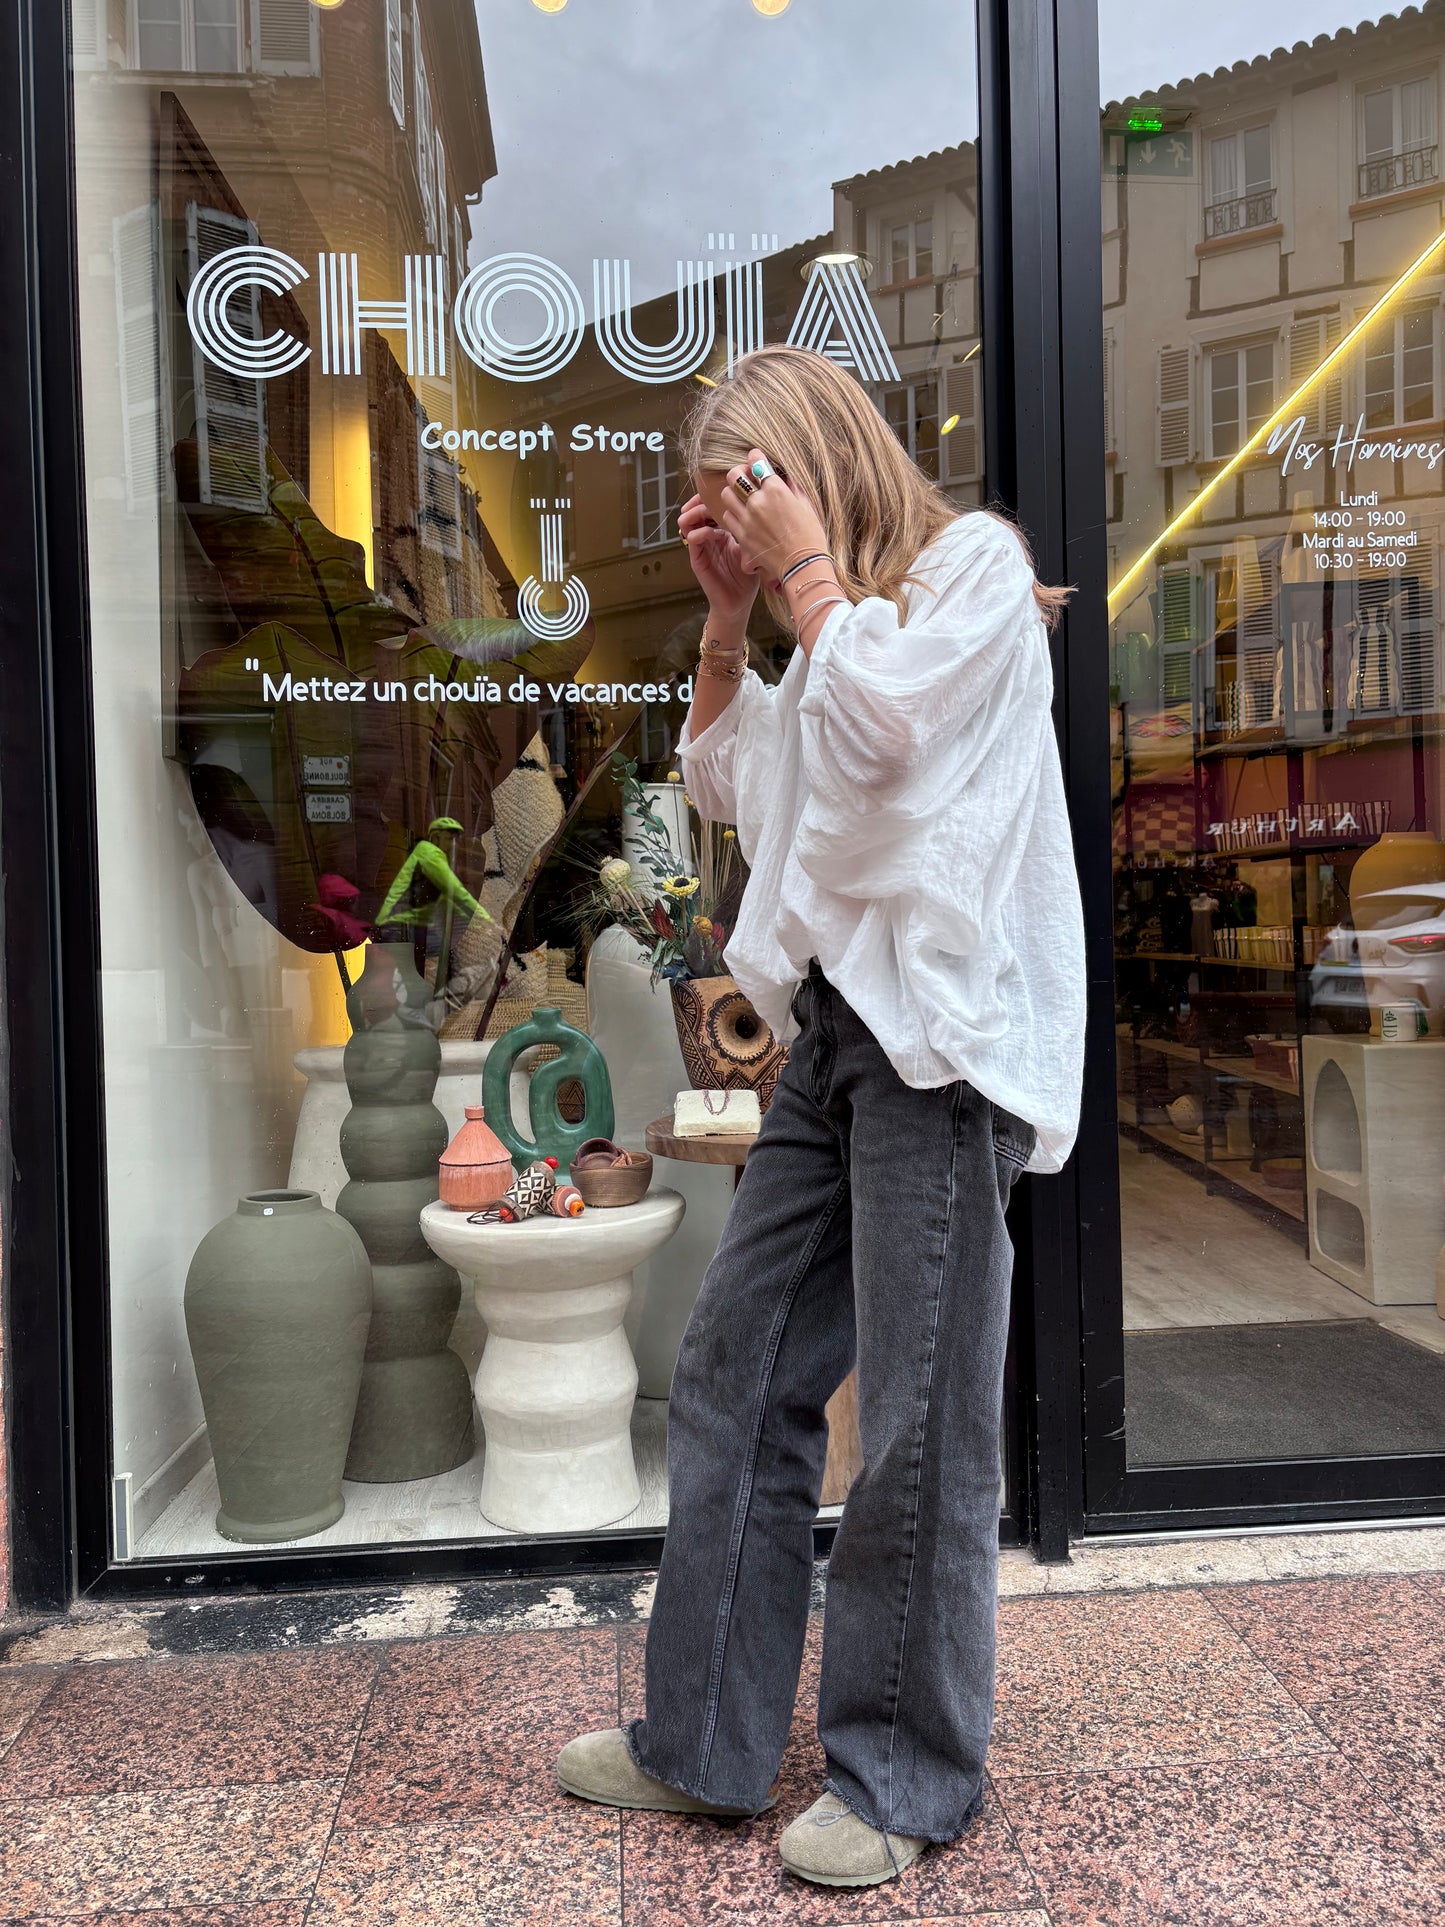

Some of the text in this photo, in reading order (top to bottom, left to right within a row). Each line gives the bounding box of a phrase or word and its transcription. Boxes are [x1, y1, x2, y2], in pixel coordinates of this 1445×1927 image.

[420, 421, 665, 460] Concept Store
[1266, 412, 1445, 477] Nos Horaires
[1340, 490, 1378, 507] Lundi
[1313, 511, 1353, 528] 14:00
[1366, 510, 1406, 527] 19:00
[1302, 531, 1418, 549] Mardi au Samedi
[1314, 553, 1354, 569] 10:30
[1367, 551, 1407, 568] 19:00
[373, 681, 407, 702] un
[413, 673, 501, 702] chouïa
[508, 674, 541, 702] de
[546, 683, 671, 703] vacances
